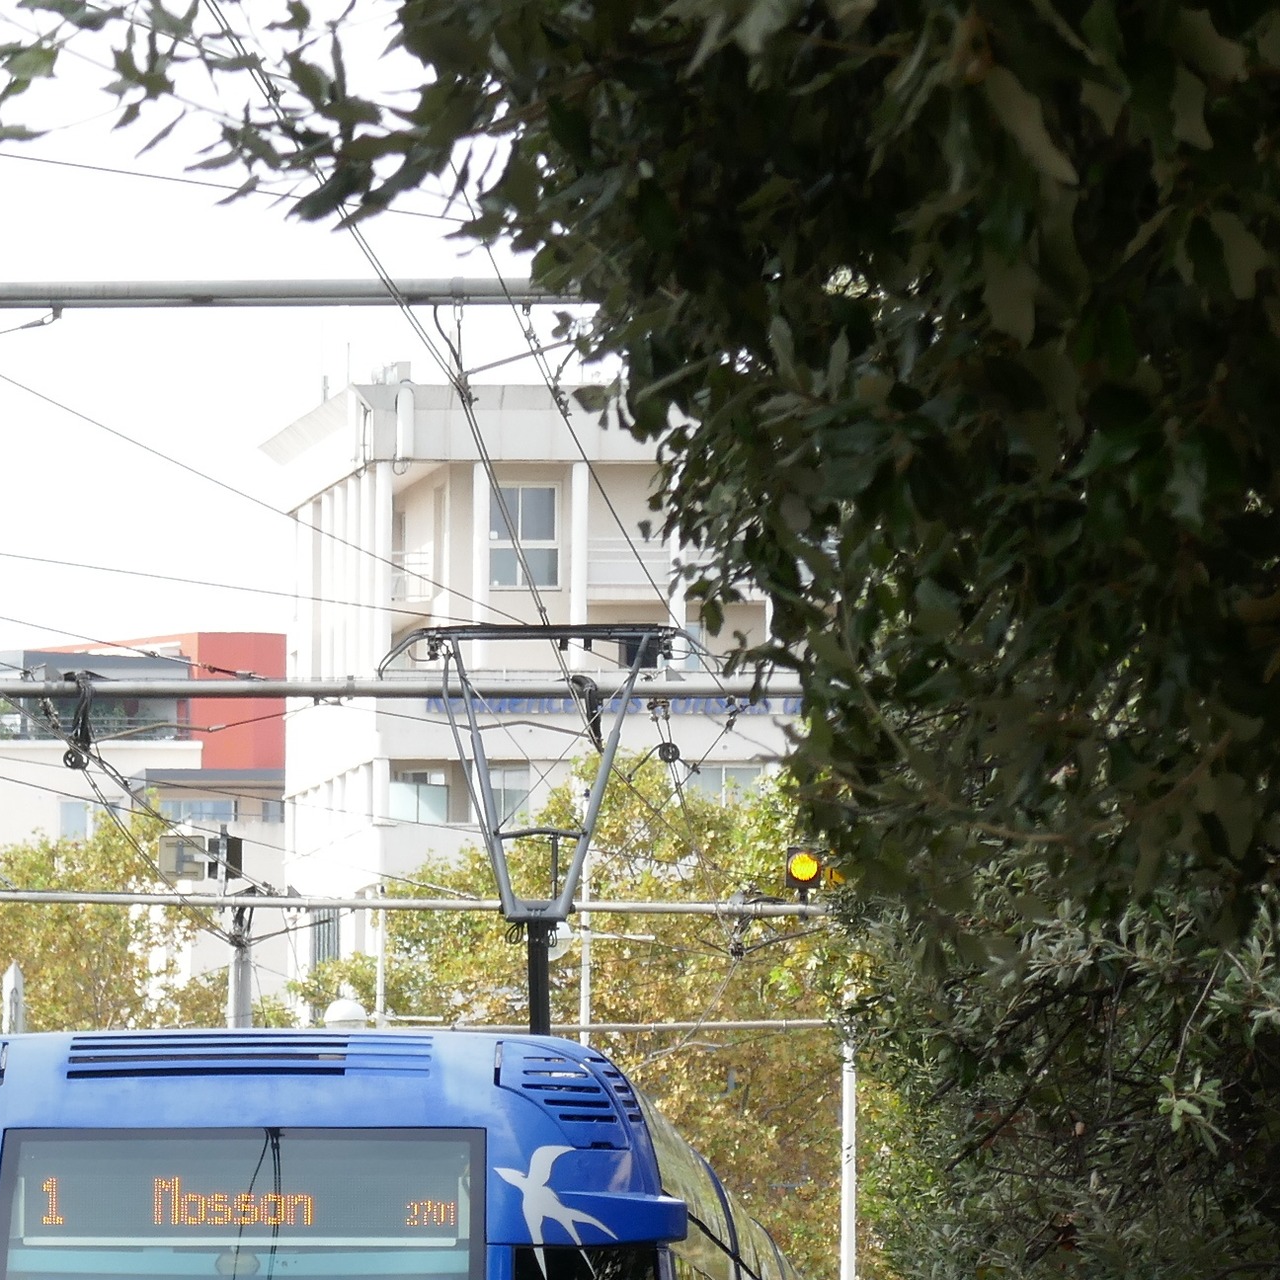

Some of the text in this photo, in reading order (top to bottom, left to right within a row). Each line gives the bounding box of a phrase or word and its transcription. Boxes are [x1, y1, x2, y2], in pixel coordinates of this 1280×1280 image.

[41, 1176, 456, 1227] 1 Mosson 2701
